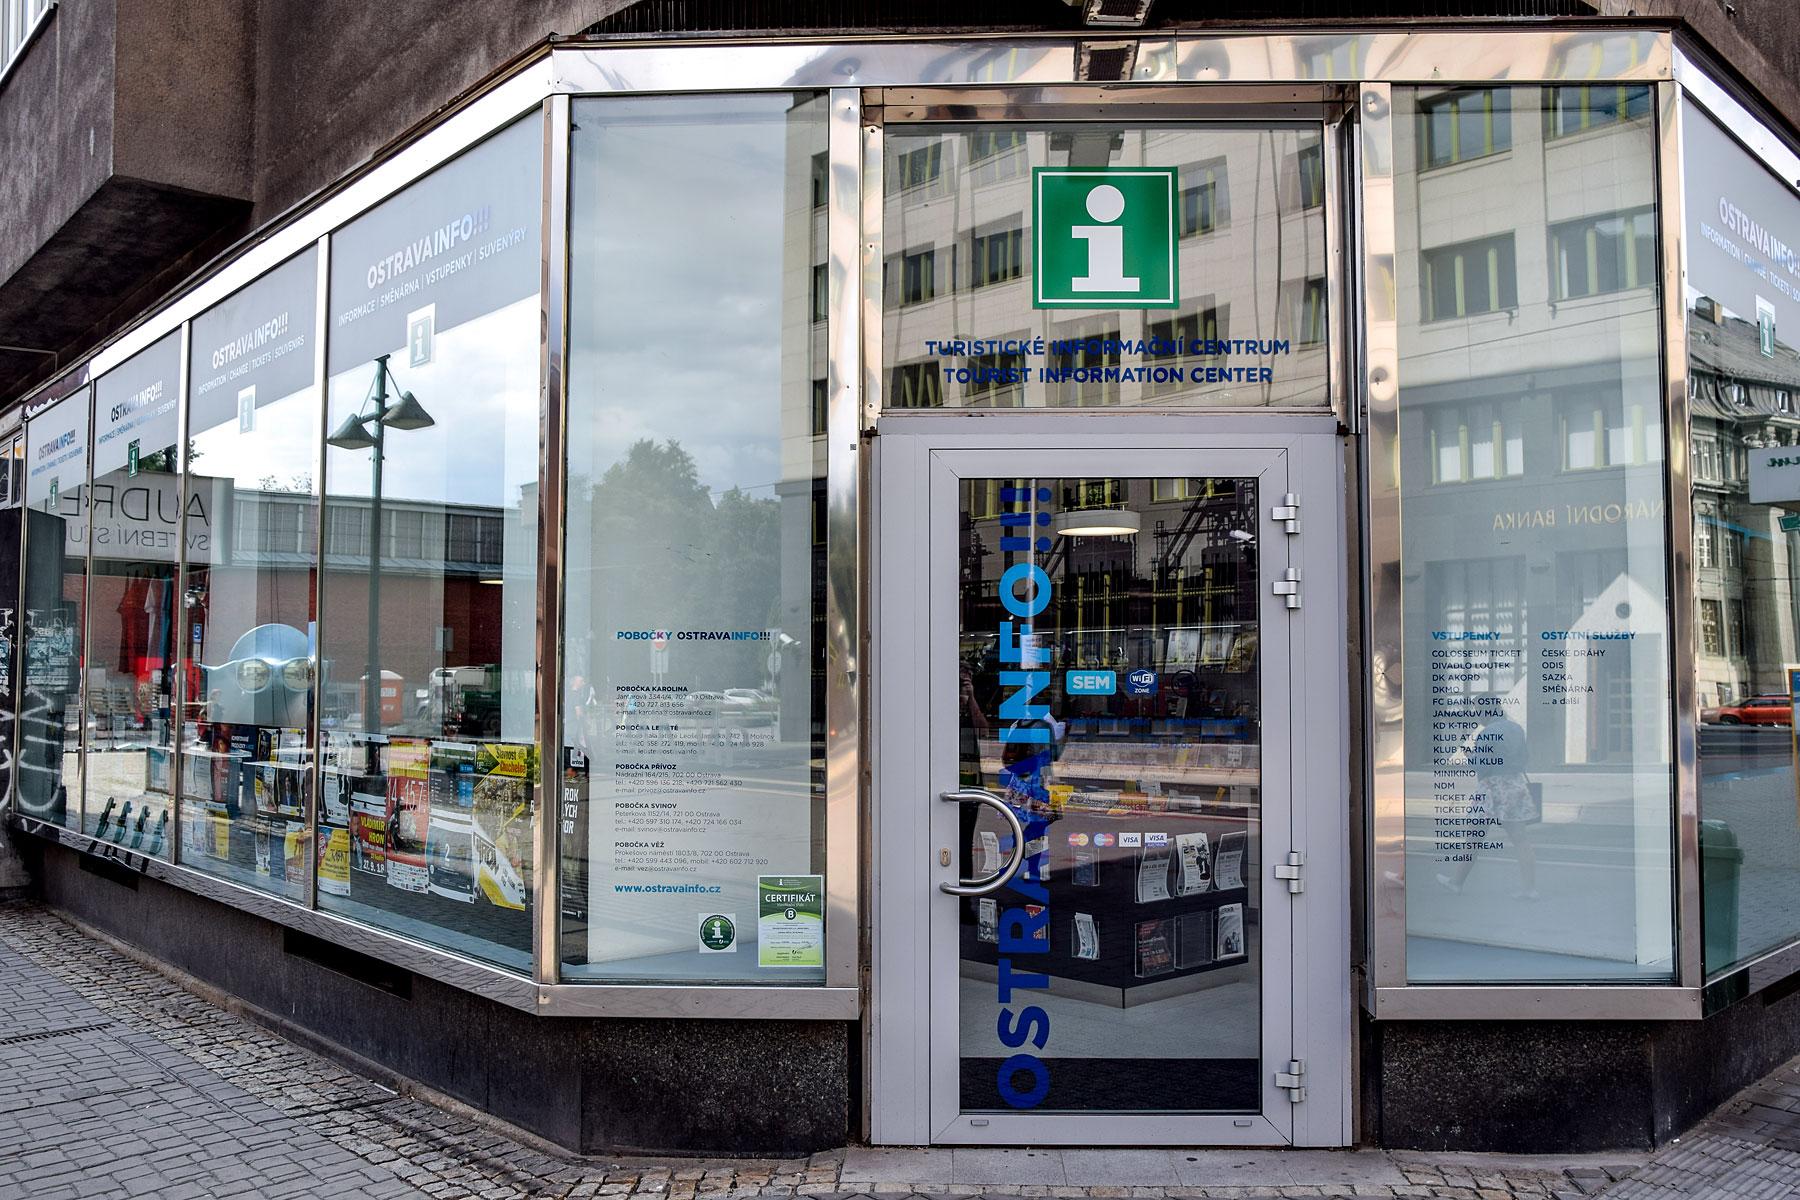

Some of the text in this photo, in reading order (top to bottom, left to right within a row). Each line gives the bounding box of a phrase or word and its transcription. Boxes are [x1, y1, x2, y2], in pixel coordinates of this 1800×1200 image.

[367, 204, 491, 289] OSTRAVAINFO!!!
[1700, 222, 1740, 261] INFORMATION
[338, 227, 527, 327] INFORMACE SMĚNÁRNA VSTUPENKY SUVENÝRY
[212, 312, 288, 369] OSTRAVAINFO!!!
[926, 335, 1290, 356] TURISTICKÉ INFORMAČNÍ CENTRUM
[198, 334, 305, 395] INFORMATION CHANGE TICKETS SOUVENIRS
[944, 366, 1273, 384] TOURIST INFORMATION CENTER
[617, 630, 770, 640] POBOČKY OSTRAVAINFO!!!
[1432, 632, 1500, 640] VSTUPENKY
[1542, 631, 1635, 640] OSTATNÍ SLUŽBY
[1574, 649, 1605, 657] DRÁHY
[1073, 676, 1110, 690] SEM
[1543, 684, 1593, 693] SMĚNÁRNA
[1448, 697, 1475, 705] BANÍK
[1484, 709, 1504, 717] MÁJ
[1434, 757, 1477, 765] KOMORNÍ
[997, 487, 1052, 1109] OSTRAVAINFO!!!
[368, 832, 385, 844] HRON
[615, 884, 720, 893] www.ostravainfo.cz
[765, 892, 816, 902] CERTIFIKÁT
[788, 910, 794, 918] B
